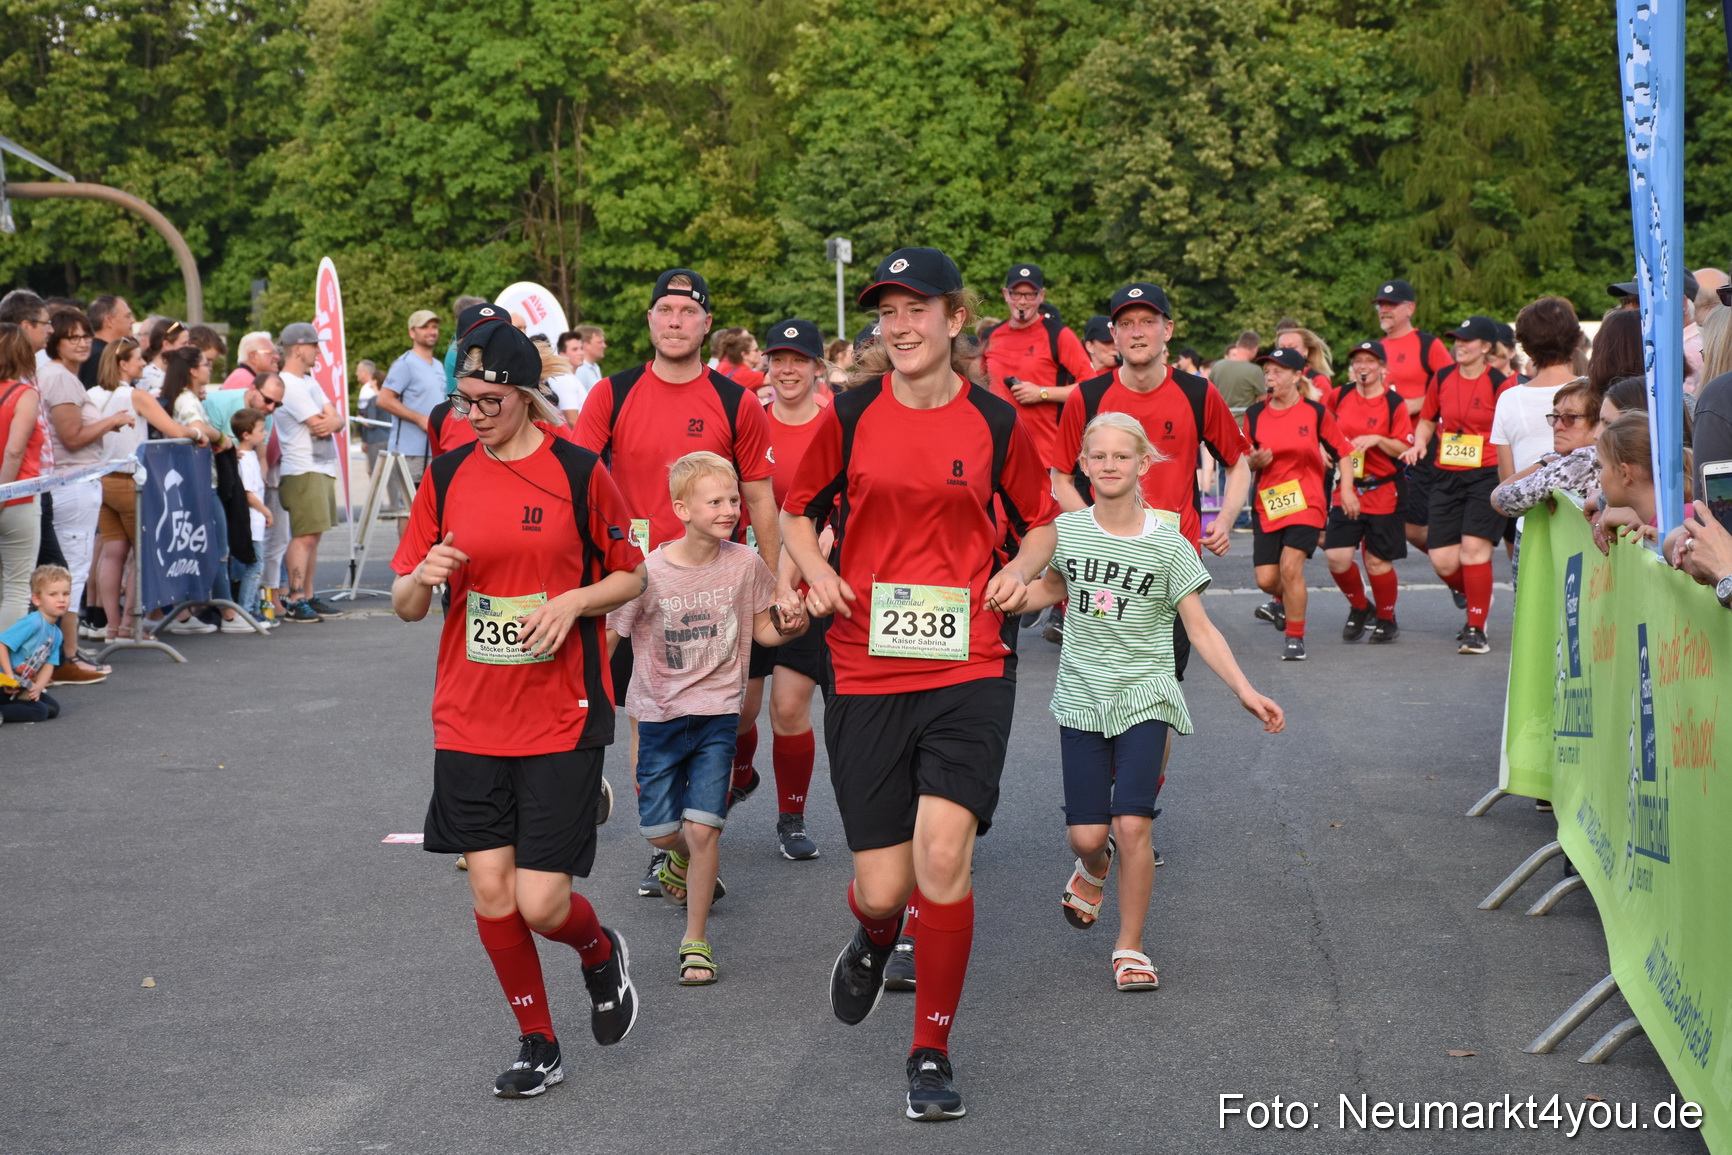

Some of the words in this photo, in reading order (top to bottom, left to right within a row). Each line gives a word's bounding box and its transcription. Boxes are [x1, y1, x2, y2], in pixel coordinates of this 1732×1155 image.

[688, 418, 704, 432] 23
[1165, 421, 1173, 434] 9
[1445, 444, 1476, 458] 2348
[952, 459, 963, 477] 8
[1268, 492, 1297, 511] 2357
[522, 506, 543, 524] 10
[1067, 558, 1154, 597] SUPER
[881, 610, 956, 638] 2338
[480, 644, 504, 652] Stöcker
